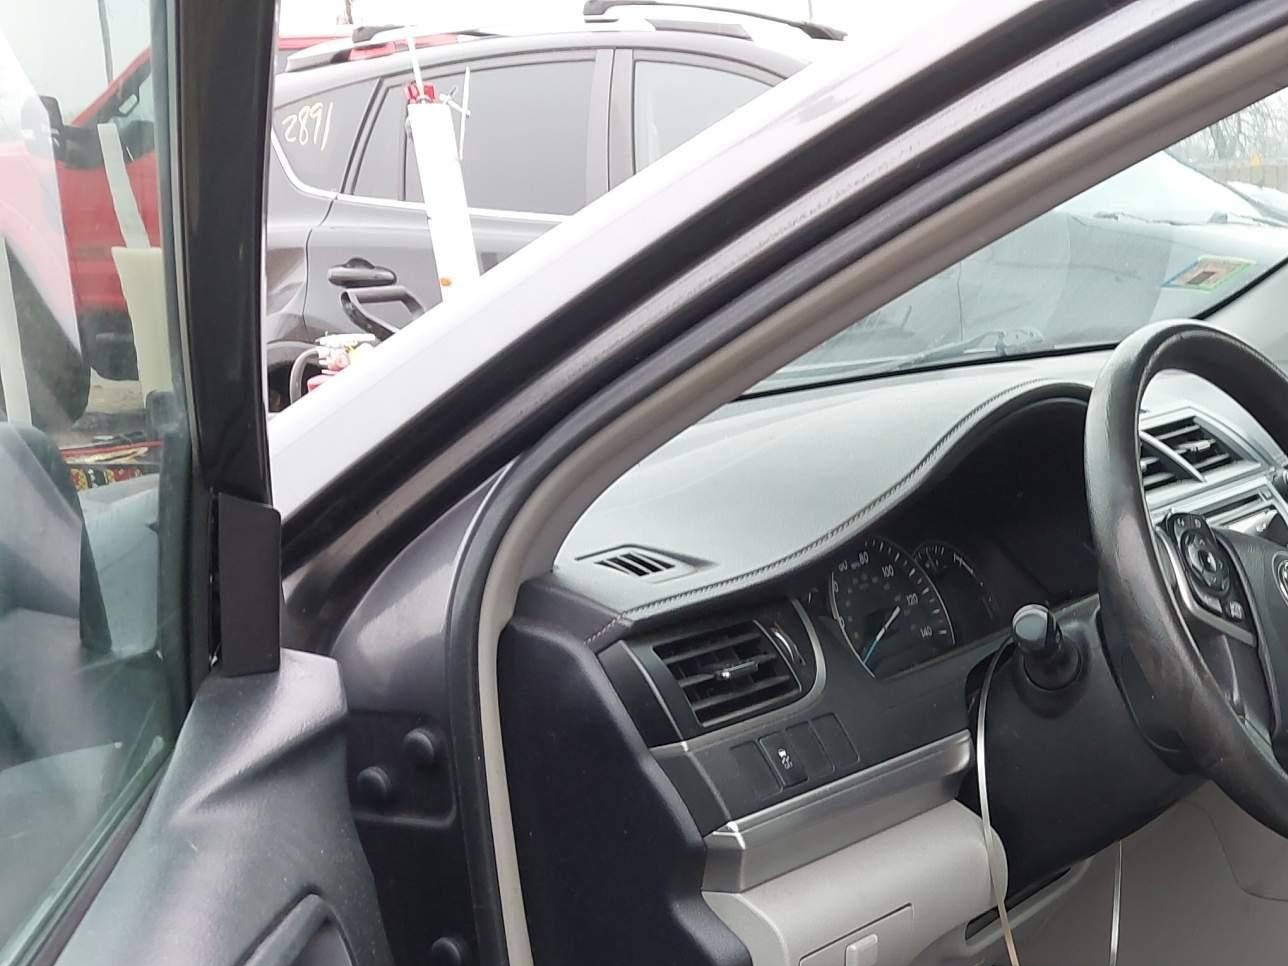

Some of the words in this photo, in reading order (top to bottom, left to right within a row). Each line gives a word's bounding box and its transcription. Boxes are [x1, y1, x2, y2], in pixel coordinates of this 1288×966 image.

[281, 102, 334, 151] 2891
[882, 565, 895, 577] 100
[907, 593, 918, 605] 120
[920, 626, 933, 639] 140
